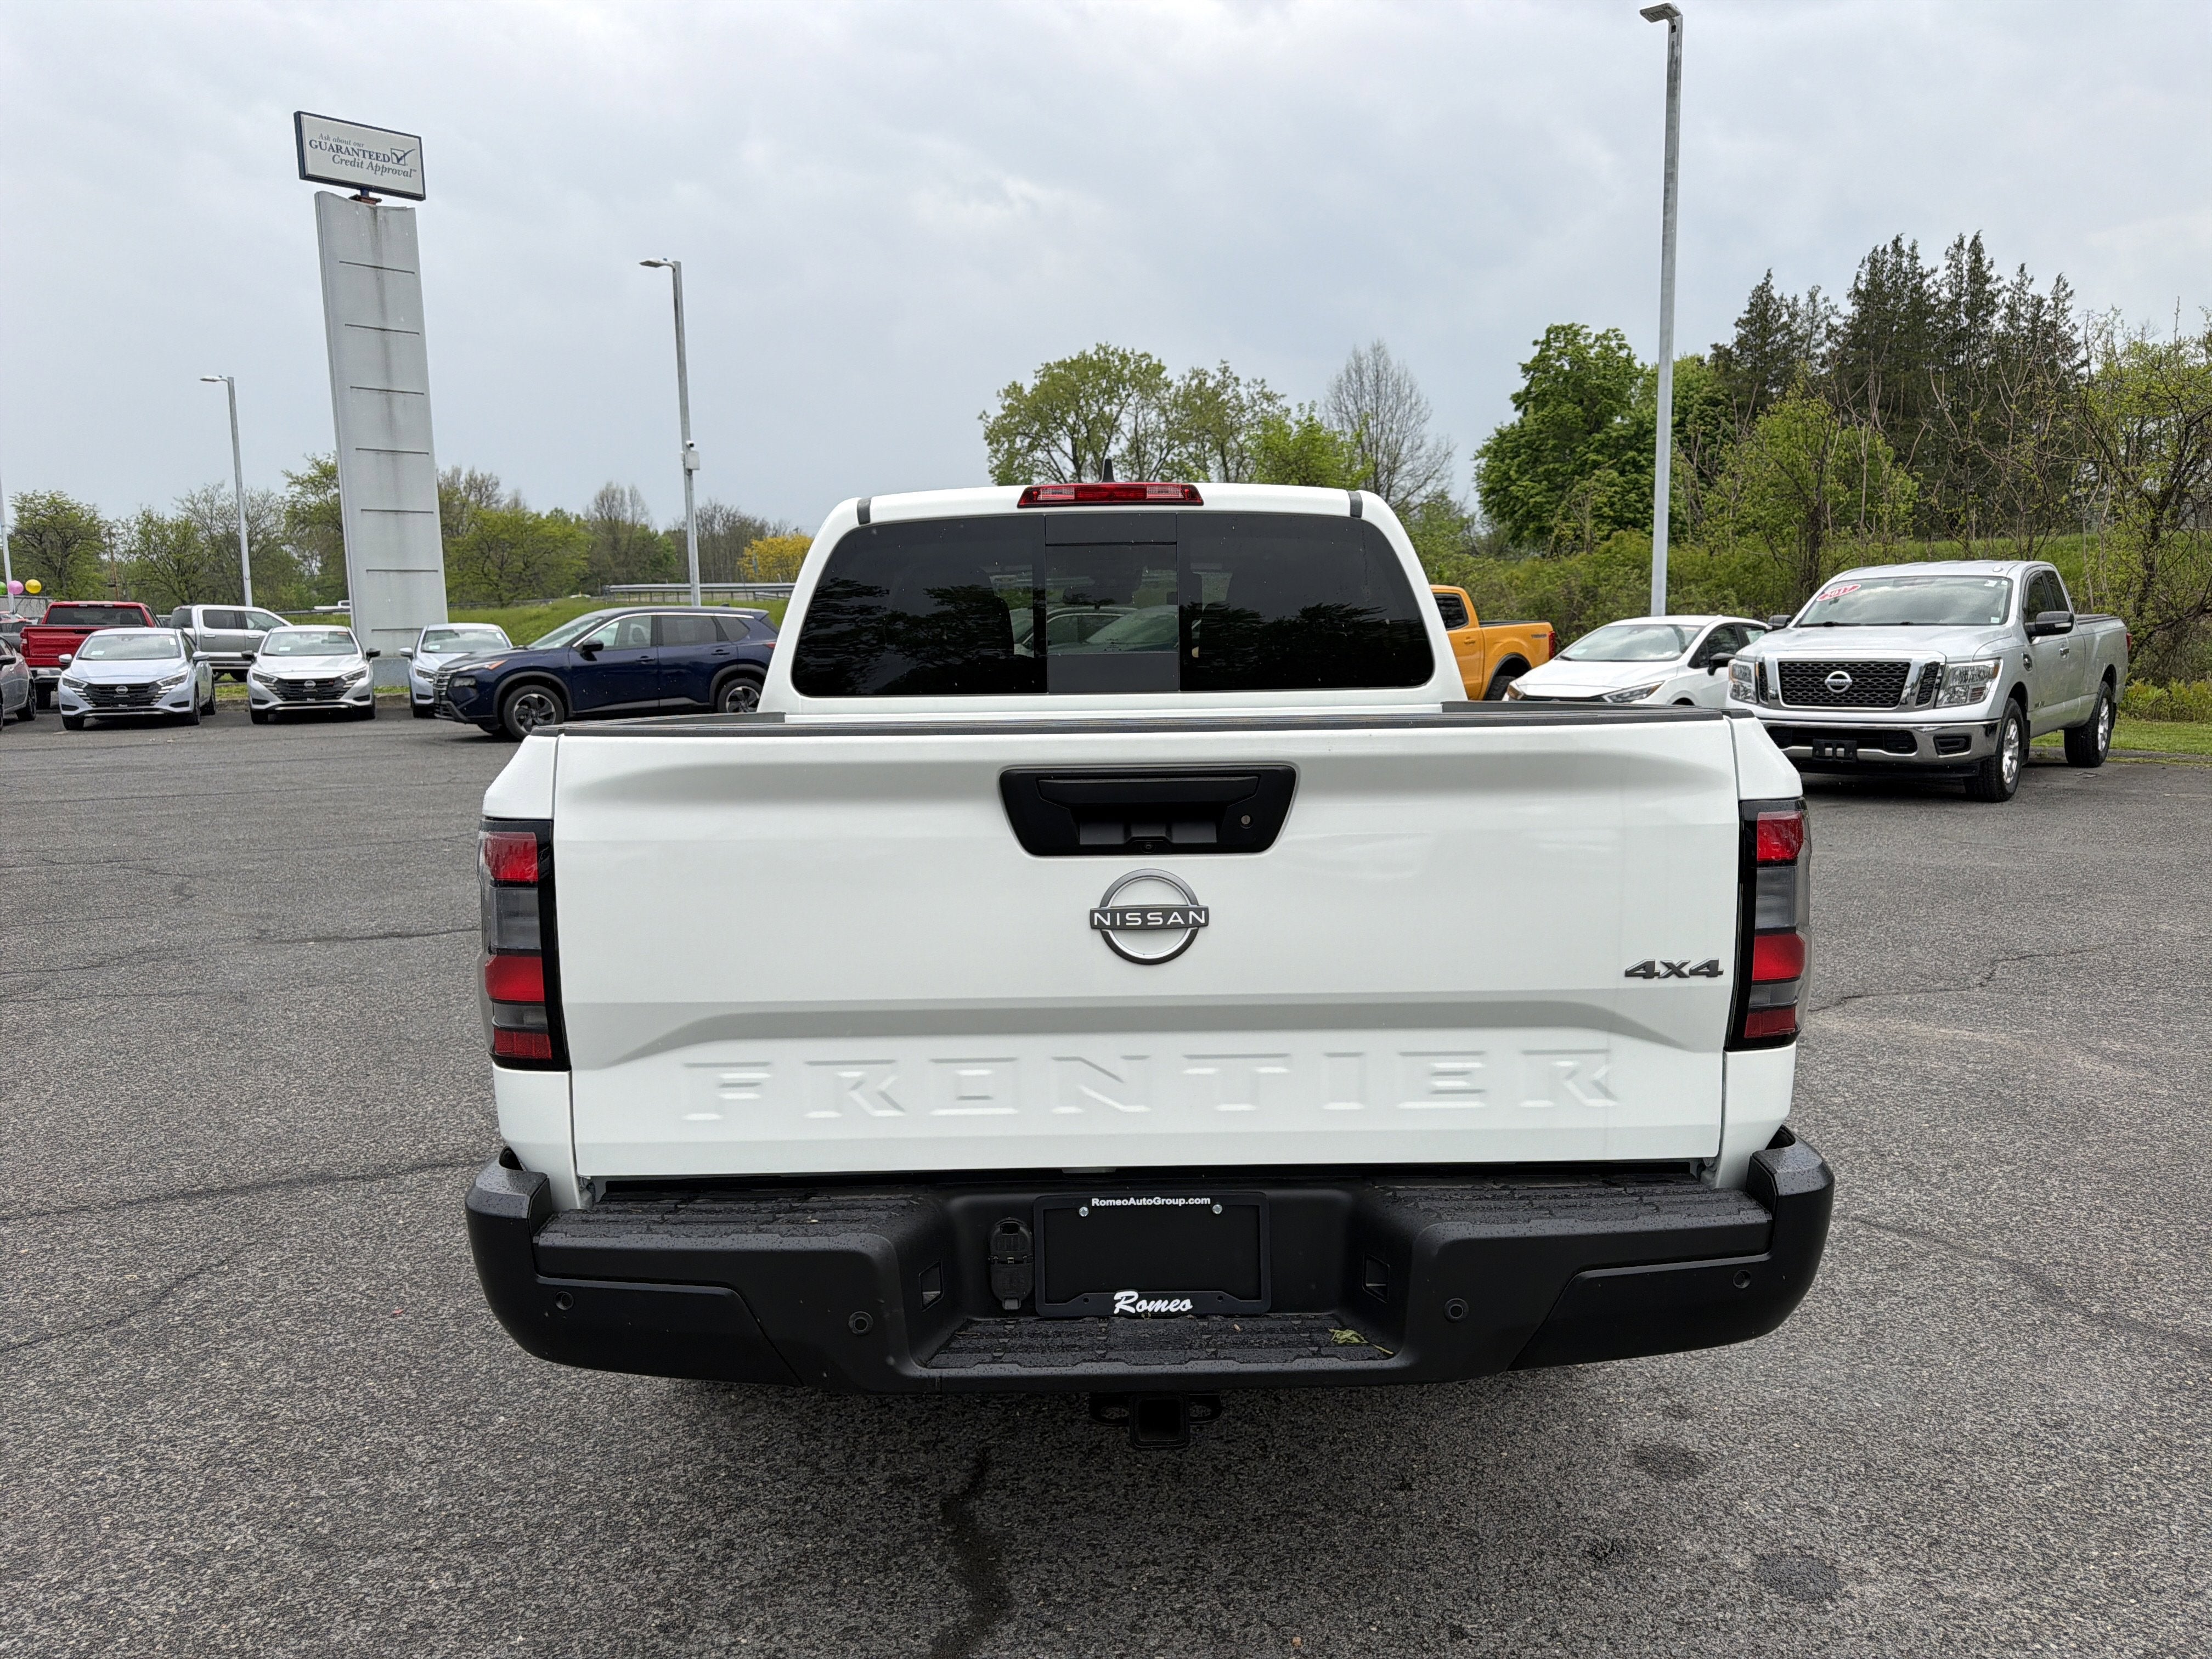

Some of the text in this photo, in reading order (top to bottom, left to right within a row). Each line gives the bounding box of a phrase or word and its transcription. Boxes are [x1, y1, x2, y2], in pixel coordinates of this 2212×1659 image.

[318, 133, 330, 141] Ask
[332, 137, 352, 145] about
[309, 139, 391, 163] GUARANTEED
[332, 154, 364, 169] Credit
[1094, 910, 1205, 926] NISSAN
[682, 1049, 1618, 1121] FRONTIER
[1091, 1197, 1211, 1206] RomeoAutoGroup.com
[1113, 1290, 1193, 1314] Romeo
